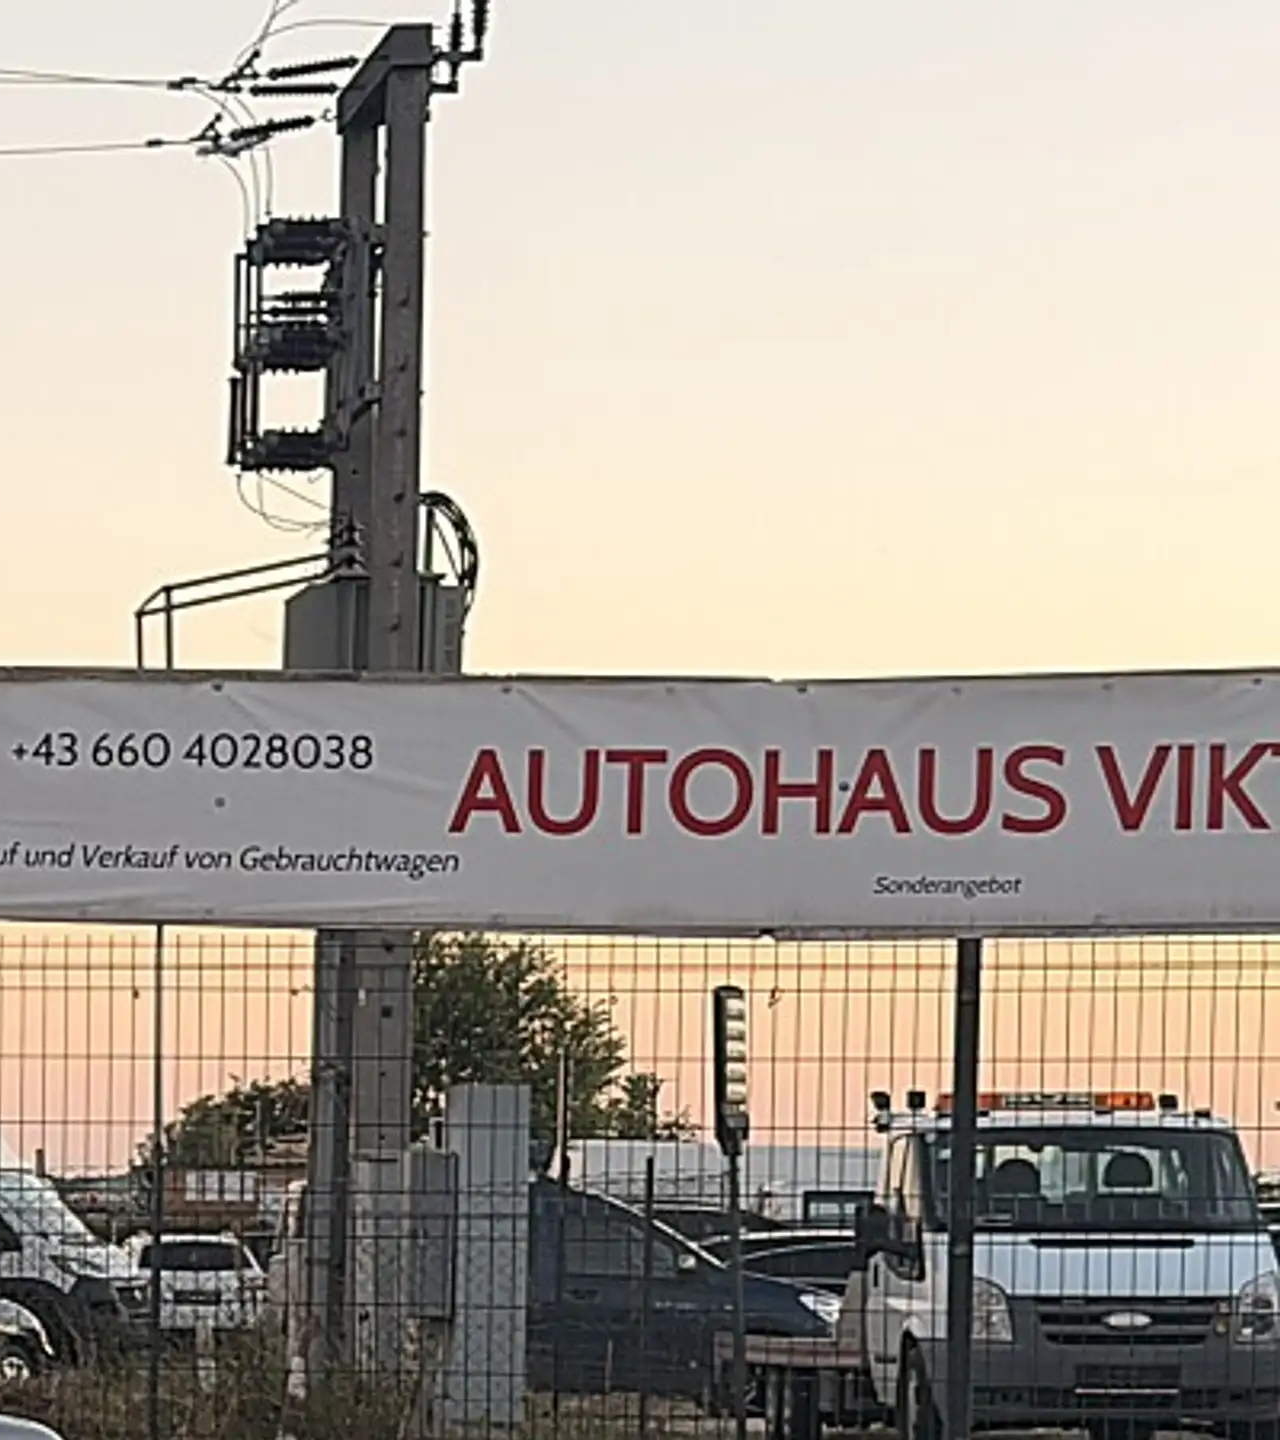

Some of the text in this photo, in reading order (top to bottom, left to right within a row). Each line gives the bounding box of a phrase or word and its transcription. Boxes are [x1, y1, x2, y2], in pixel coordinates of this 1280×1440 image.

[11, 732, 373, 770] +43 660 4028038
[448, 741, 1280, 838] AUTOHAUS VIK
[25, 844, 75, 868] und
[82, 844, 180, 869] Verkauf
[184, 851, 232, 869] von
[239, 845, 460, 881] Gebrauchtwagen
[873, 875, 1023, 900] Sonderangebot
